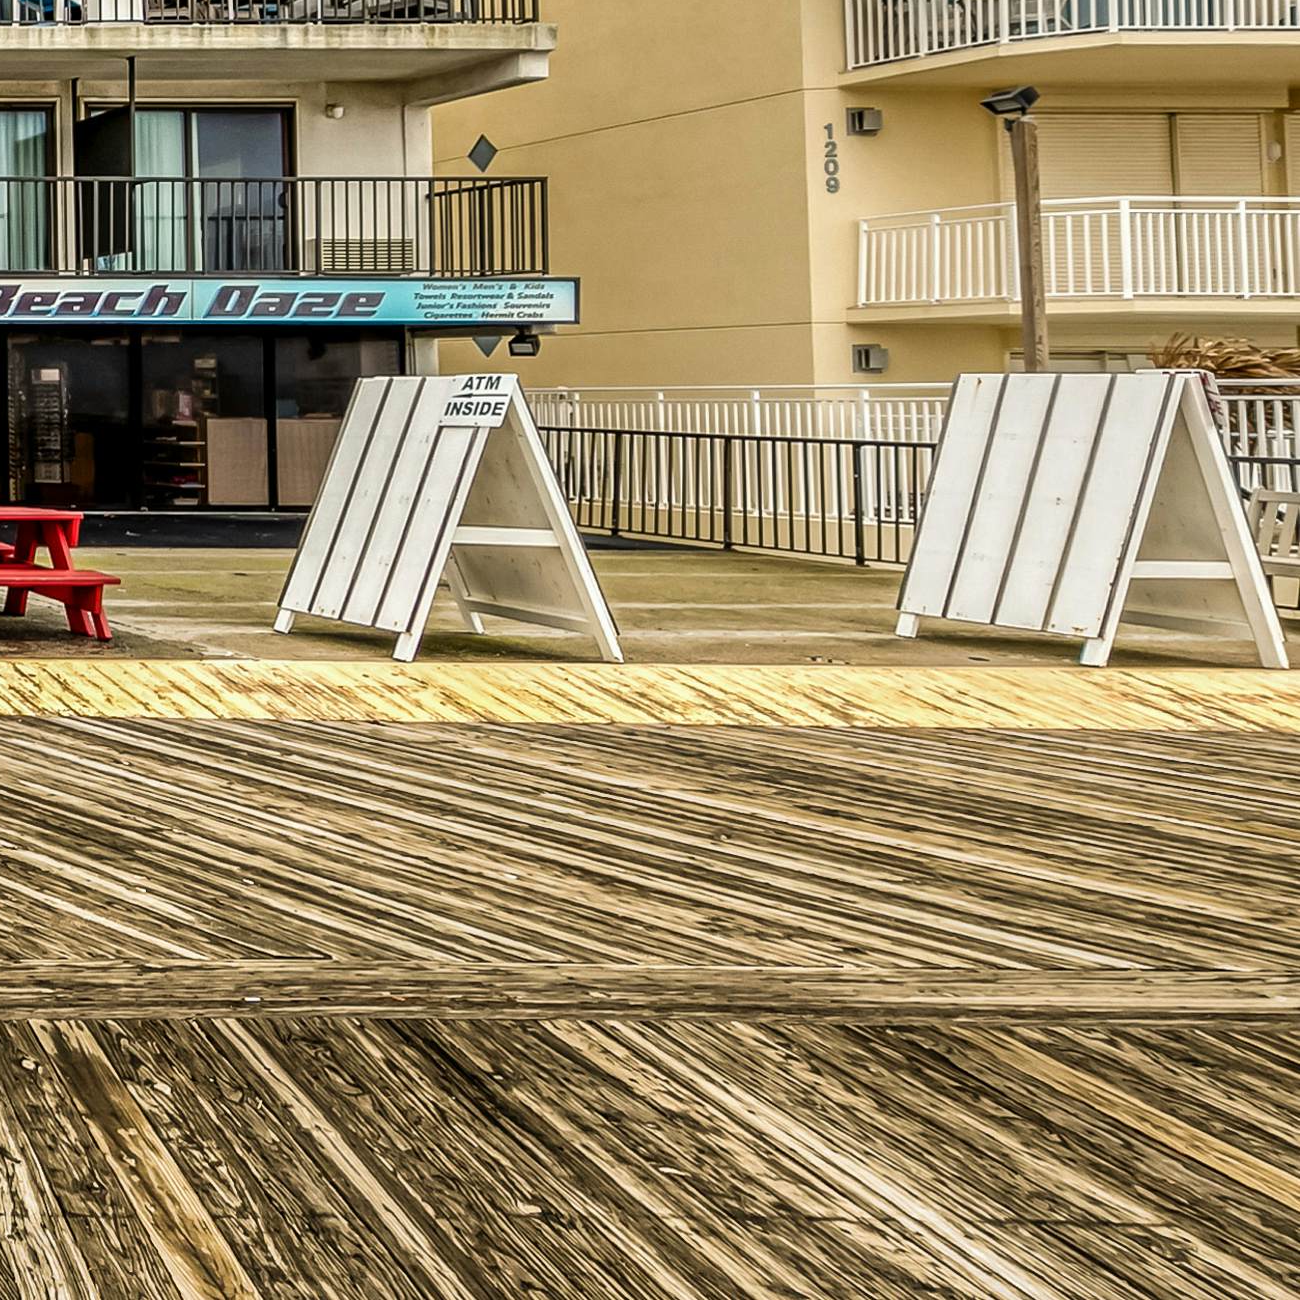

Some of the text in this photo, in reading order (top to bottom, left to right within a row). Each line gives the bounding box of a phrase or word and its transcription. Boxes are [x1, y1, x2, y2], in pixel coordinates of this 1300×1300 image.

[824, 123, 840, 194] 1209
[201, 284, 387, 318] Daze
[517, 292, 554, 300] Sandals
[416, 302, 454, 310] Junior's
[504, 301, 550, 309] Souvenirs
[424, 311, 543, 320] Cigarettes Hermit Crabs
[461, 376, 502, 390] ATM
[444, 401, 505, 416] INSIDE
